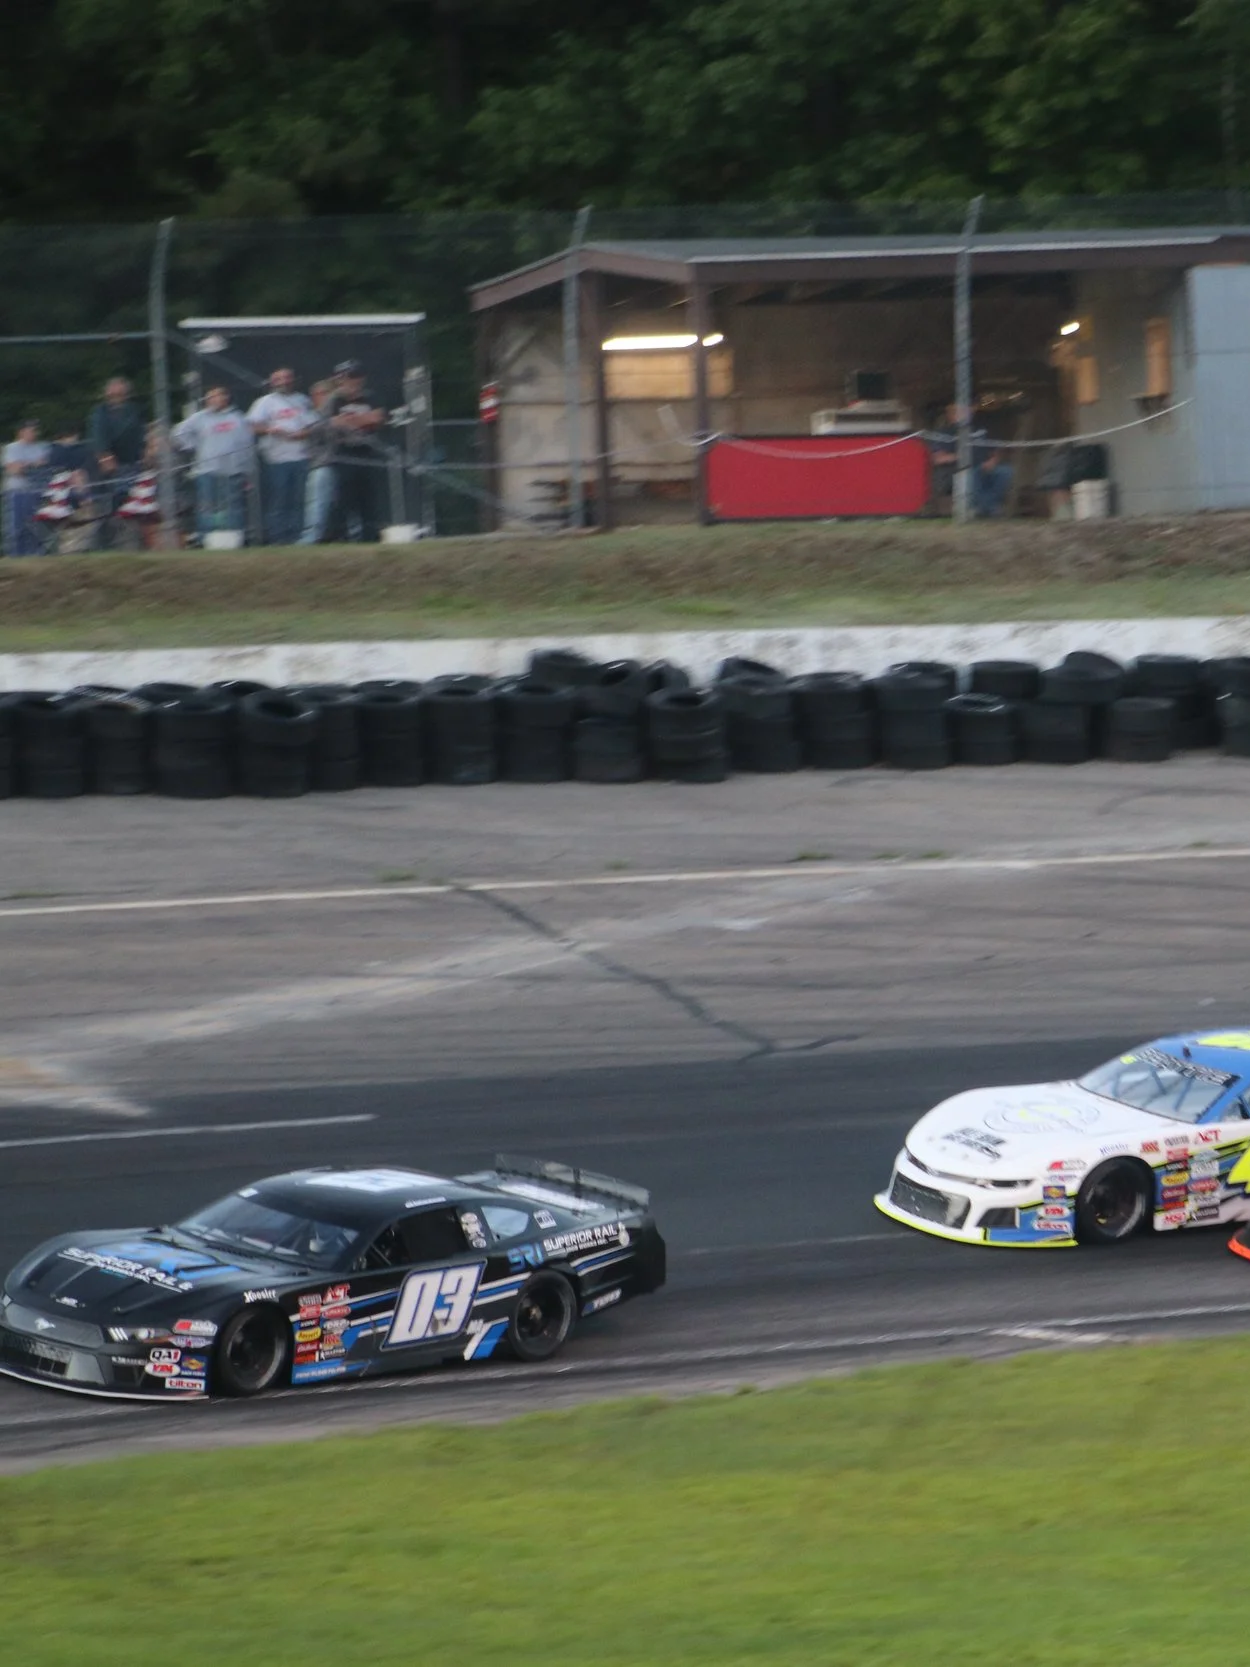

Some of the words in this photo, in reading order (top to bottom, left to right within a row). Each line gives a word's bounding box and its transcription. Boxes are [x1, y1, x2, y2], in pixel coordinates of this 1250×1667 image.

[544, 1229, 593, 1252] SUPERIOR
[594, 1224, 618, 1238] RAIL
[507, 1242, 545, 1273] SRI
[389, 1260, 488, 1346] 03
[151, 1349, 179, 1360] QA1
[169, 1380, 202, 1389] tilton
